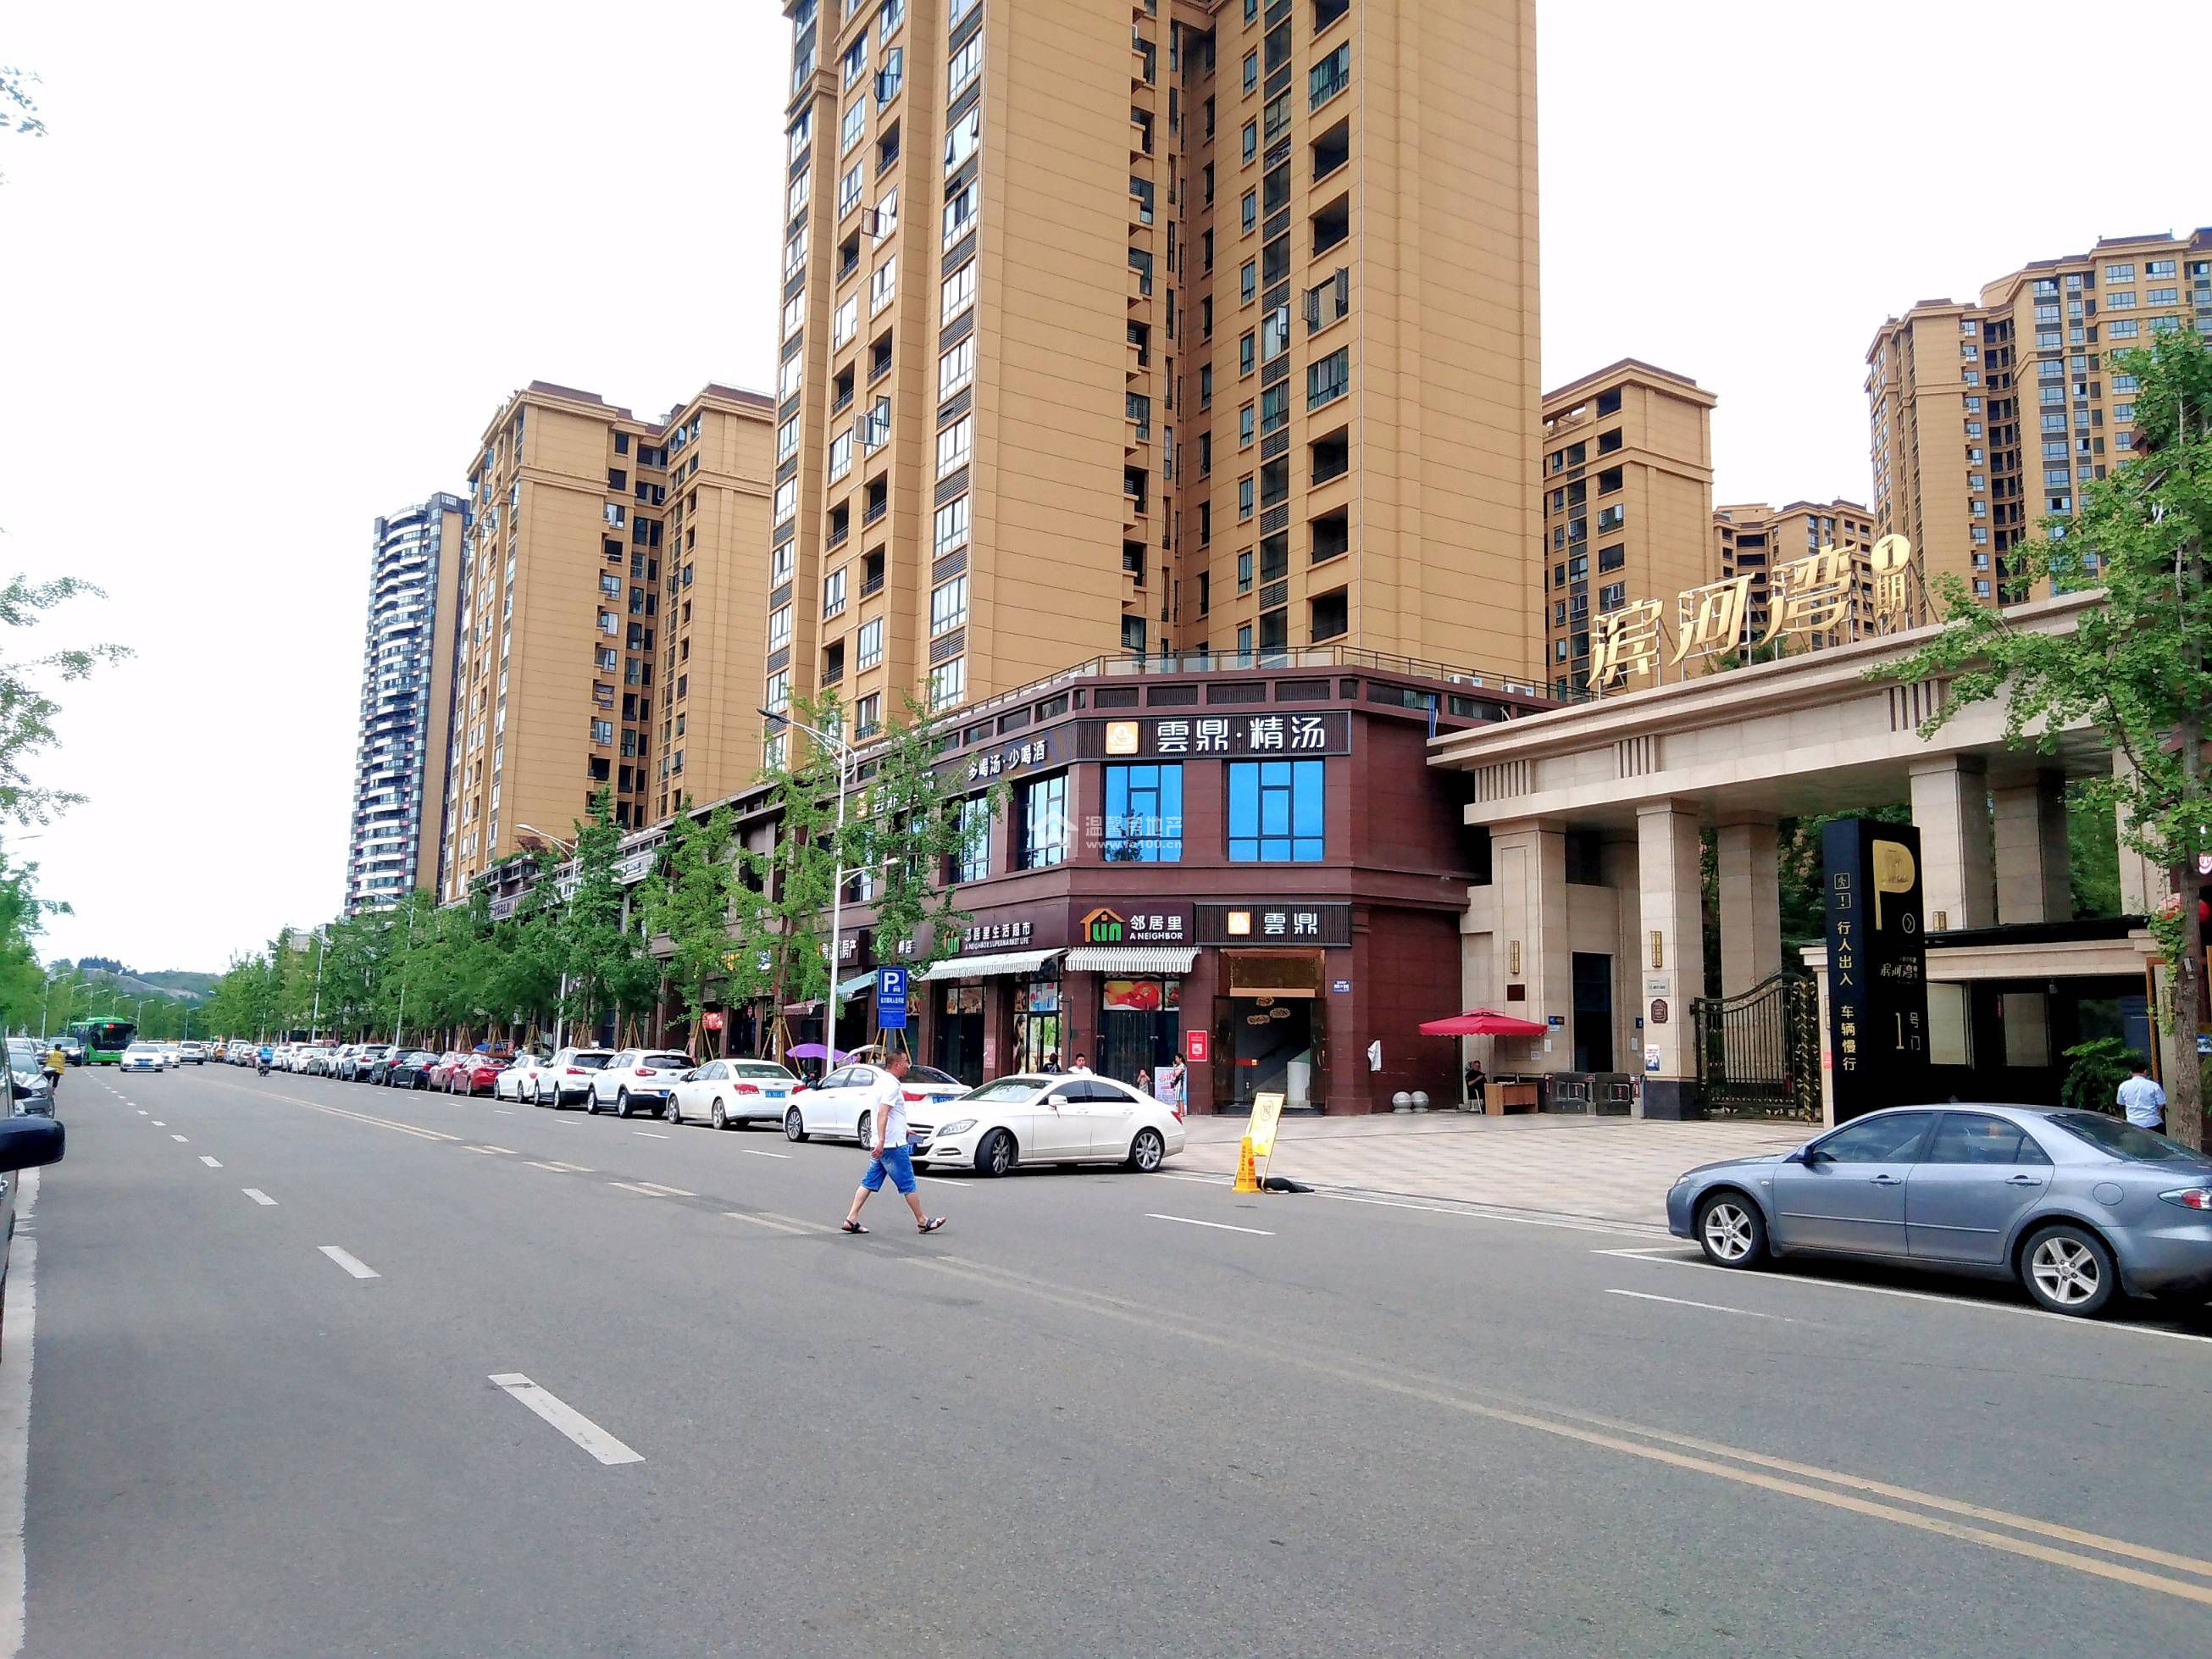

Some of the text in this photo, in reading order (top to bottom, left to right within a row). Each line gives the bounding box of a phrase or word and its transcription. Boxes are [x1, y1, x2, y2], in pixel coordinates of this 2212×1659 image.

[1586, 542, 1857, 687] 滨河湾
[1129, 915, 1182, 930] 邻居里
[1138, 932, 1183, 940] NEIGHBOR
[884, 972, 900, 992] P
[1837, 921, 1857, 1071] 行人出入 车辆慢行
